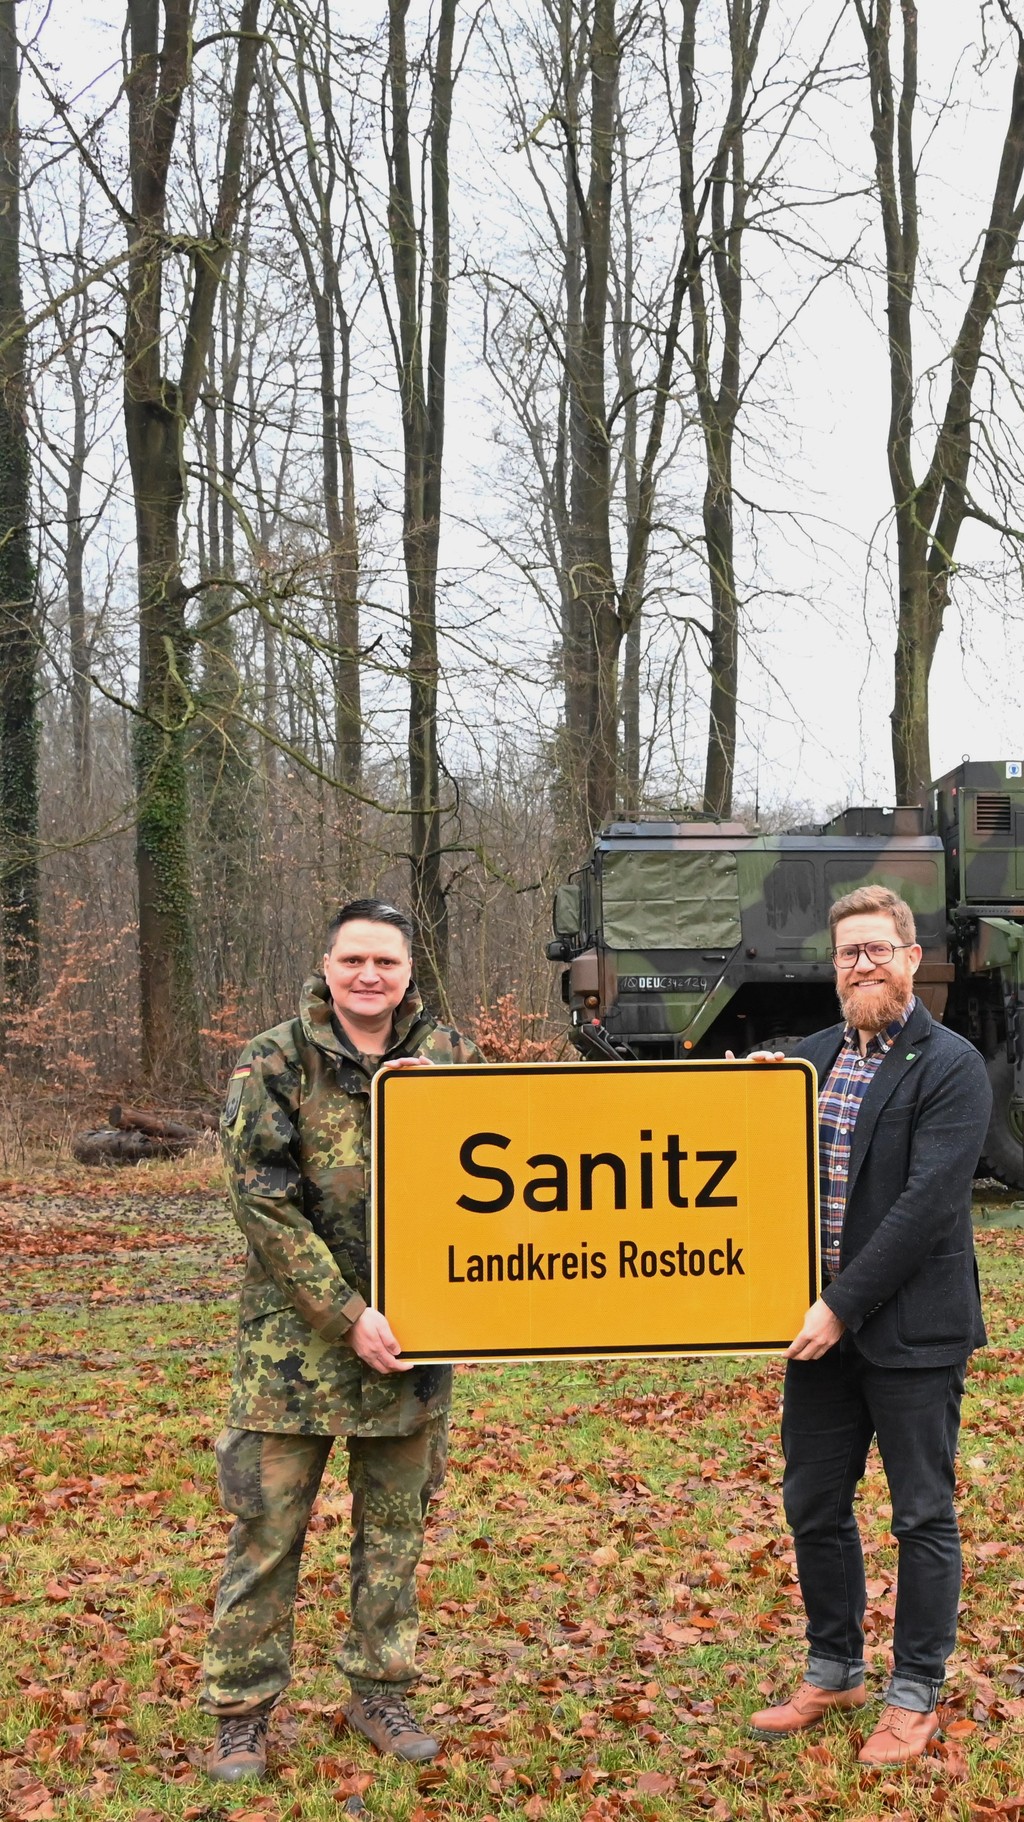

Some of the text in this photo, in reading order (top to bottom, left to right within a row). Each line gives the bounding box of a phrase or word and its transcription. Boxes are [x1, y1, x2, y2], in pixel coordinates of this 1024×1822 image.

[639, 977, 660, 988] DEU
[456, 1130, 738, 1214] Sanitz
[448, 1238, 746, 1283] Landkreis Rostock
